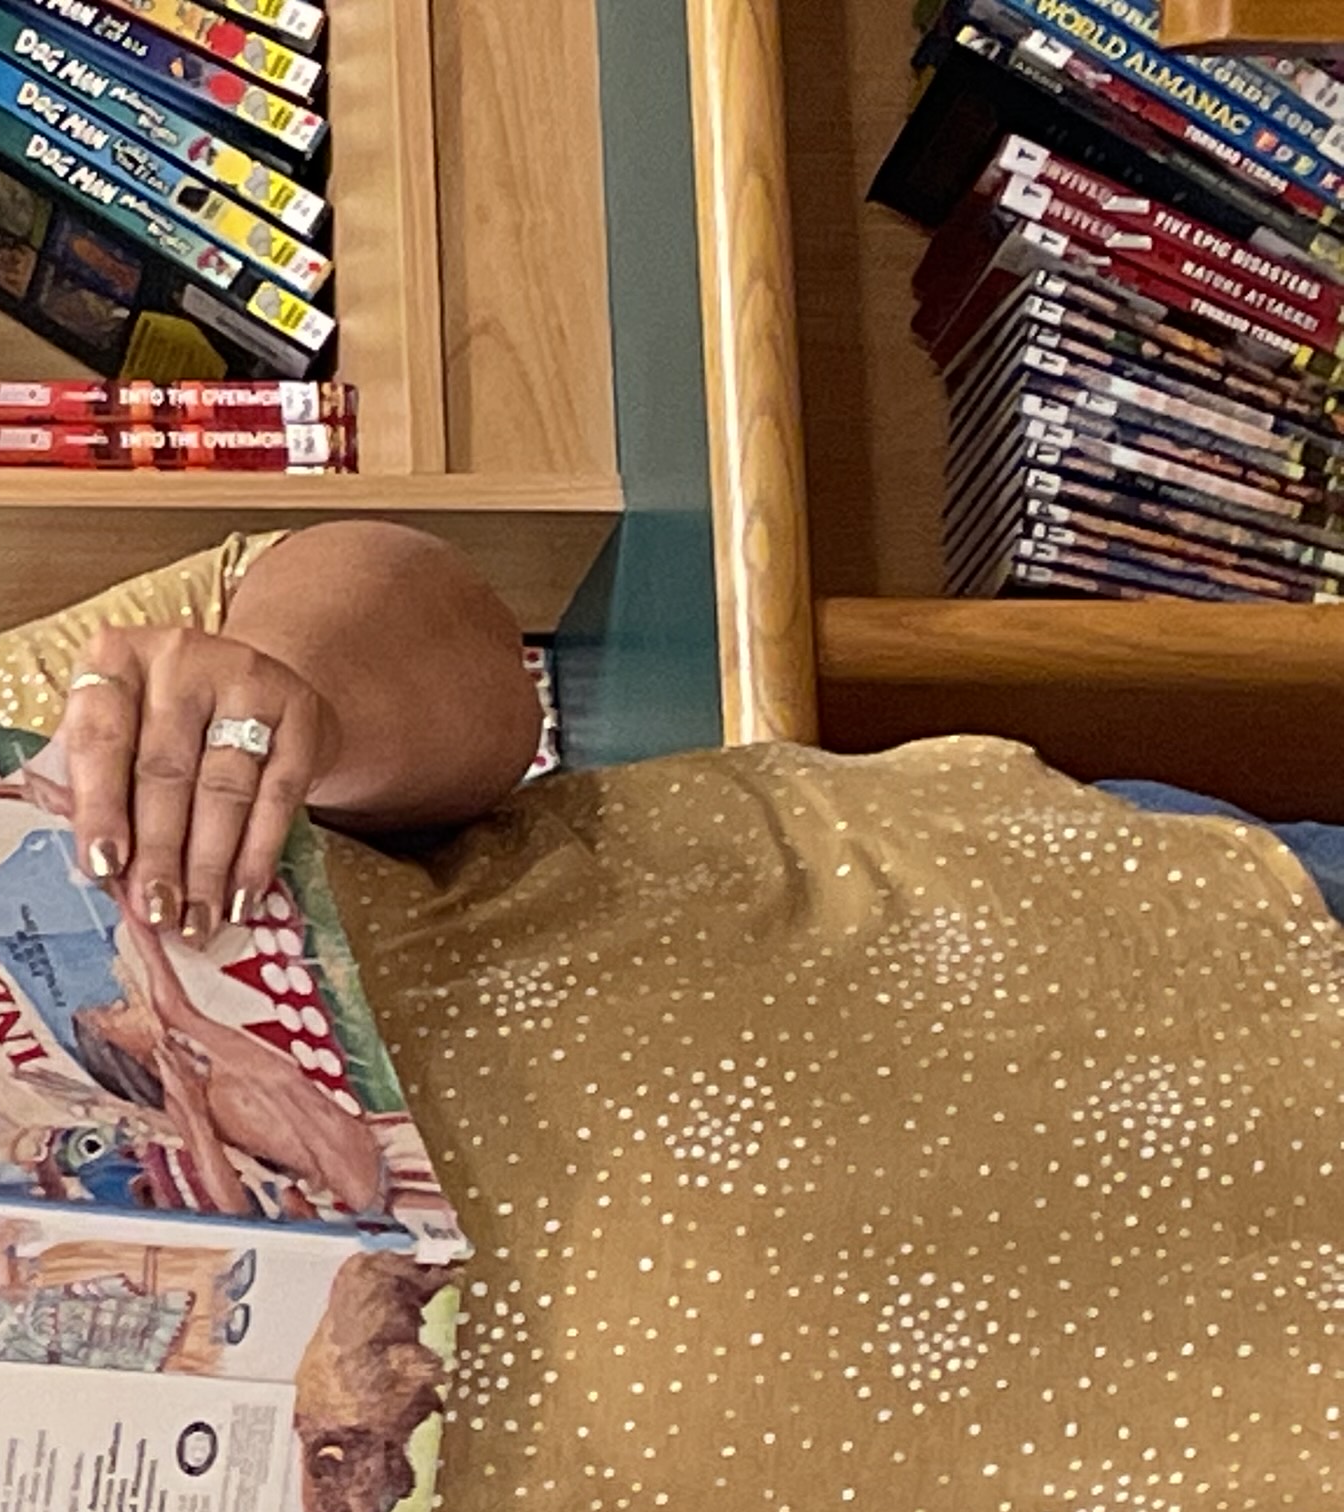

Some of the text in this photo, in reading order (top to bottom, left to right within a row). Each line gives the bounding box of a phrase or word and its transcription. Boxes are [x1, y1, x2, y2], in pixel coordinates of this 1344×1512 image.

[14, 28, 65, 68] DOG
[58, 60, 110, 98] MAN
[1123, 47, 1252, 140] ALMANAC
[17, 82, 68, 121] DOG
[59, 112, 110, 150] MAN
[25, 135, 75, 173] DOG
[68, 167, 121, 206] MAN
[1151, 211, 1322, 302] FIVE EPIC DISASTERS
[1179, 259, 1243, 299] NATURE
